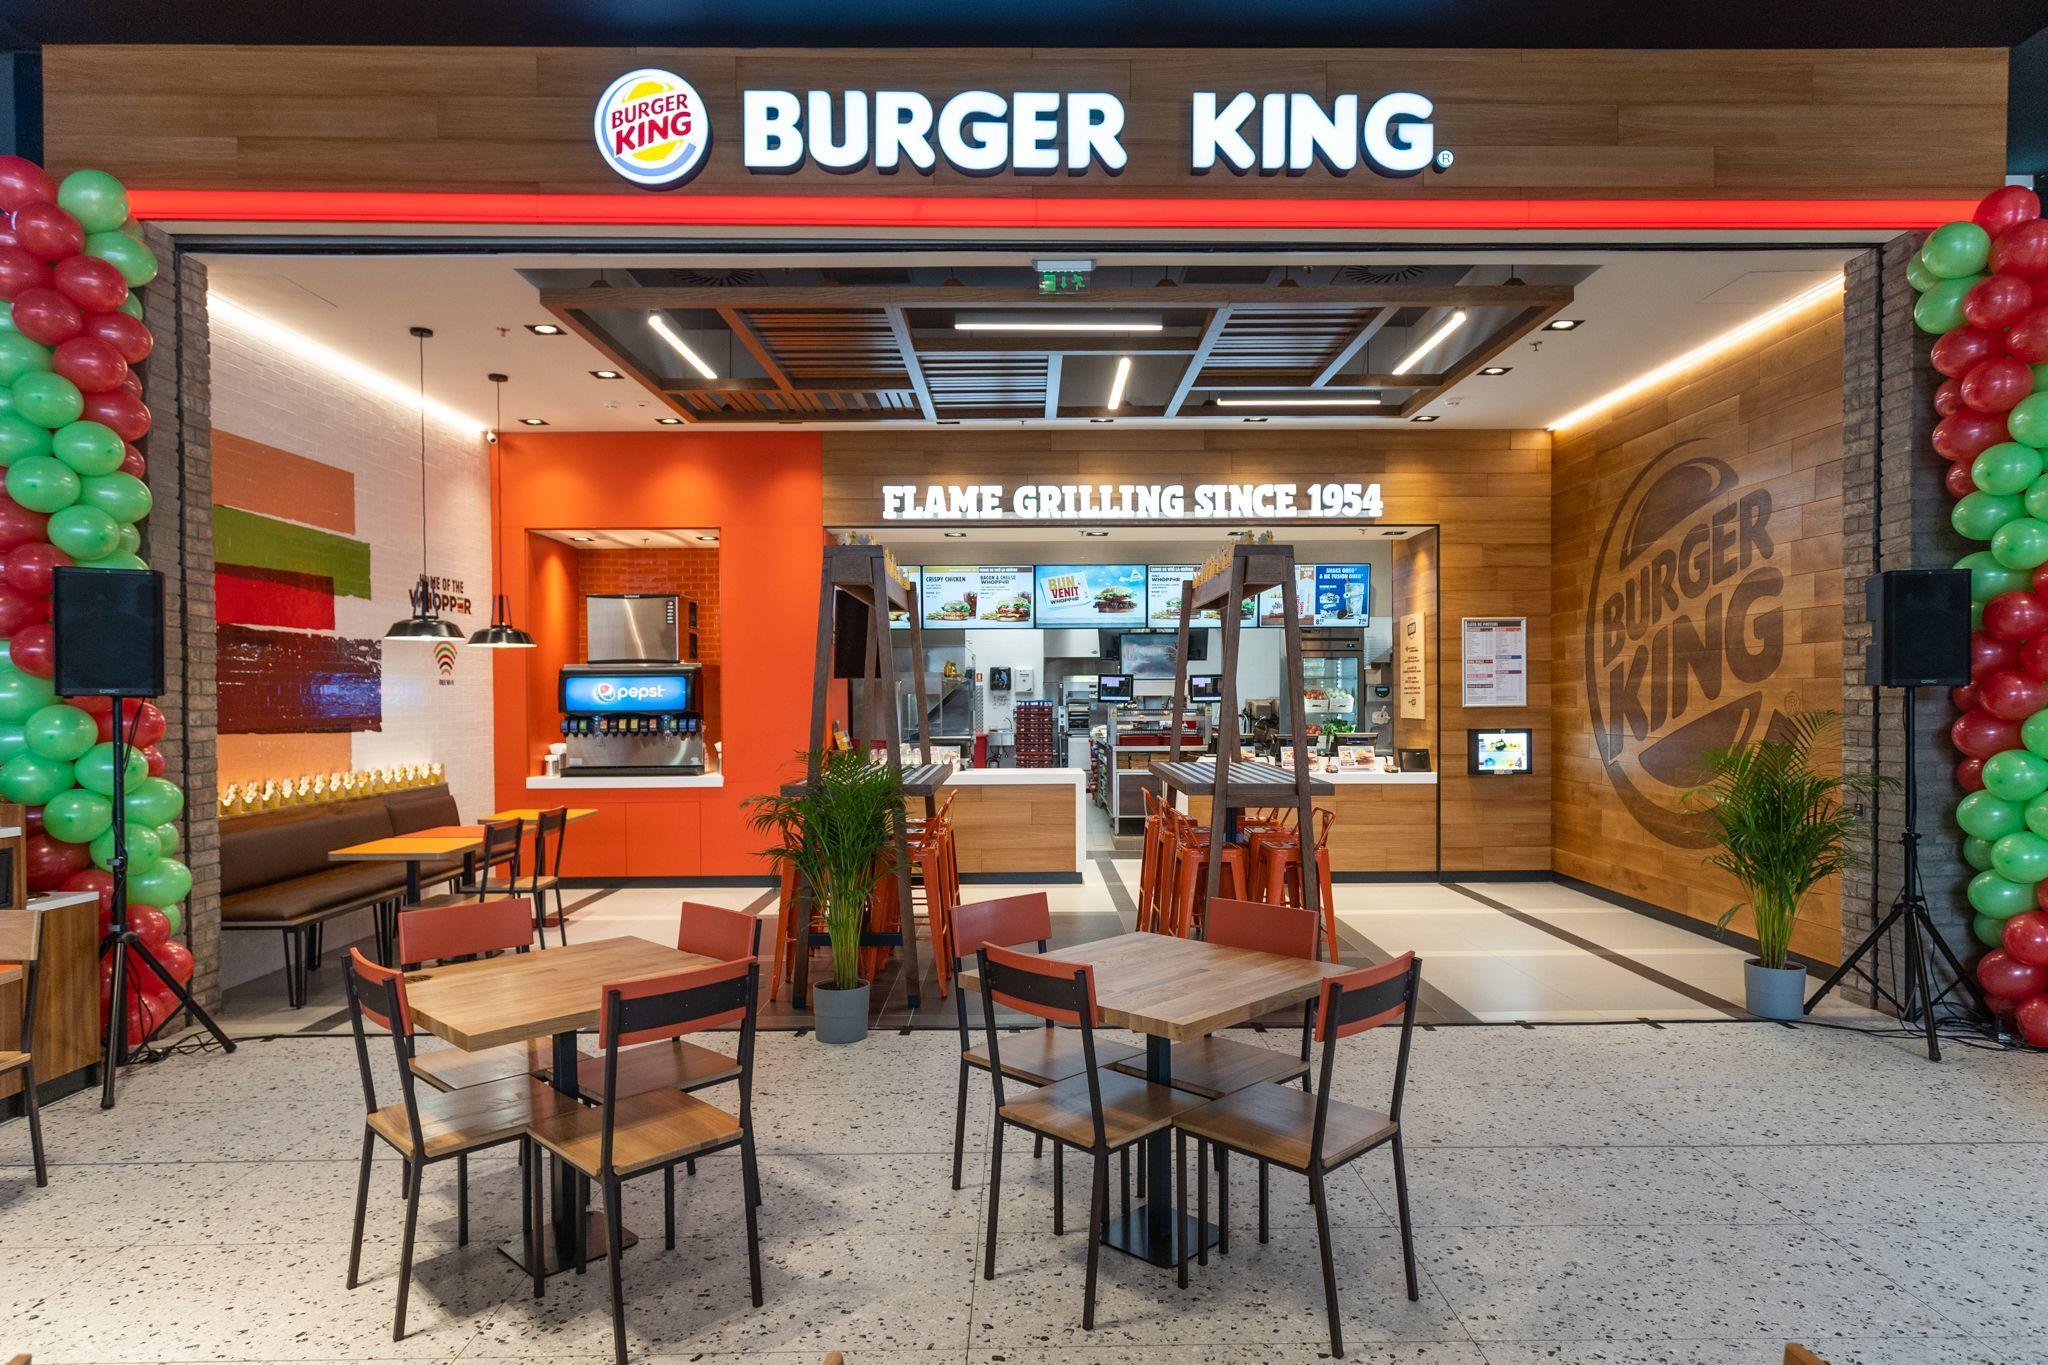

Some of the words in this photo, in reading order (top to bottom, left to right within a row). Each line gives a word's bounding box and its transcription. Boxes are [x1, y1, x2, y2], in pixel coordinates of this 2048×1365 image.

[611, 93, 688, 129] BURGER
[744, 90, 1128, 170] BURGER
[1193, 92, 1434, 171] KING
[615, 111, 691, 156] KING
[882, 485, 1003, 519] FLAME
[1013, 485, 1185, 519] GRILLING
[1194, 484, 1297, 518] SINCE
[1305, 483, 1384, 517] 1954
[442, 578, 451, 592] OF
[452, 580, 464, 594] THE
[1051, 586, 1079, 599] VENIT
[1603, 488, 1775, 668] BURGER
[1609, 566, 1784, 760] KING
